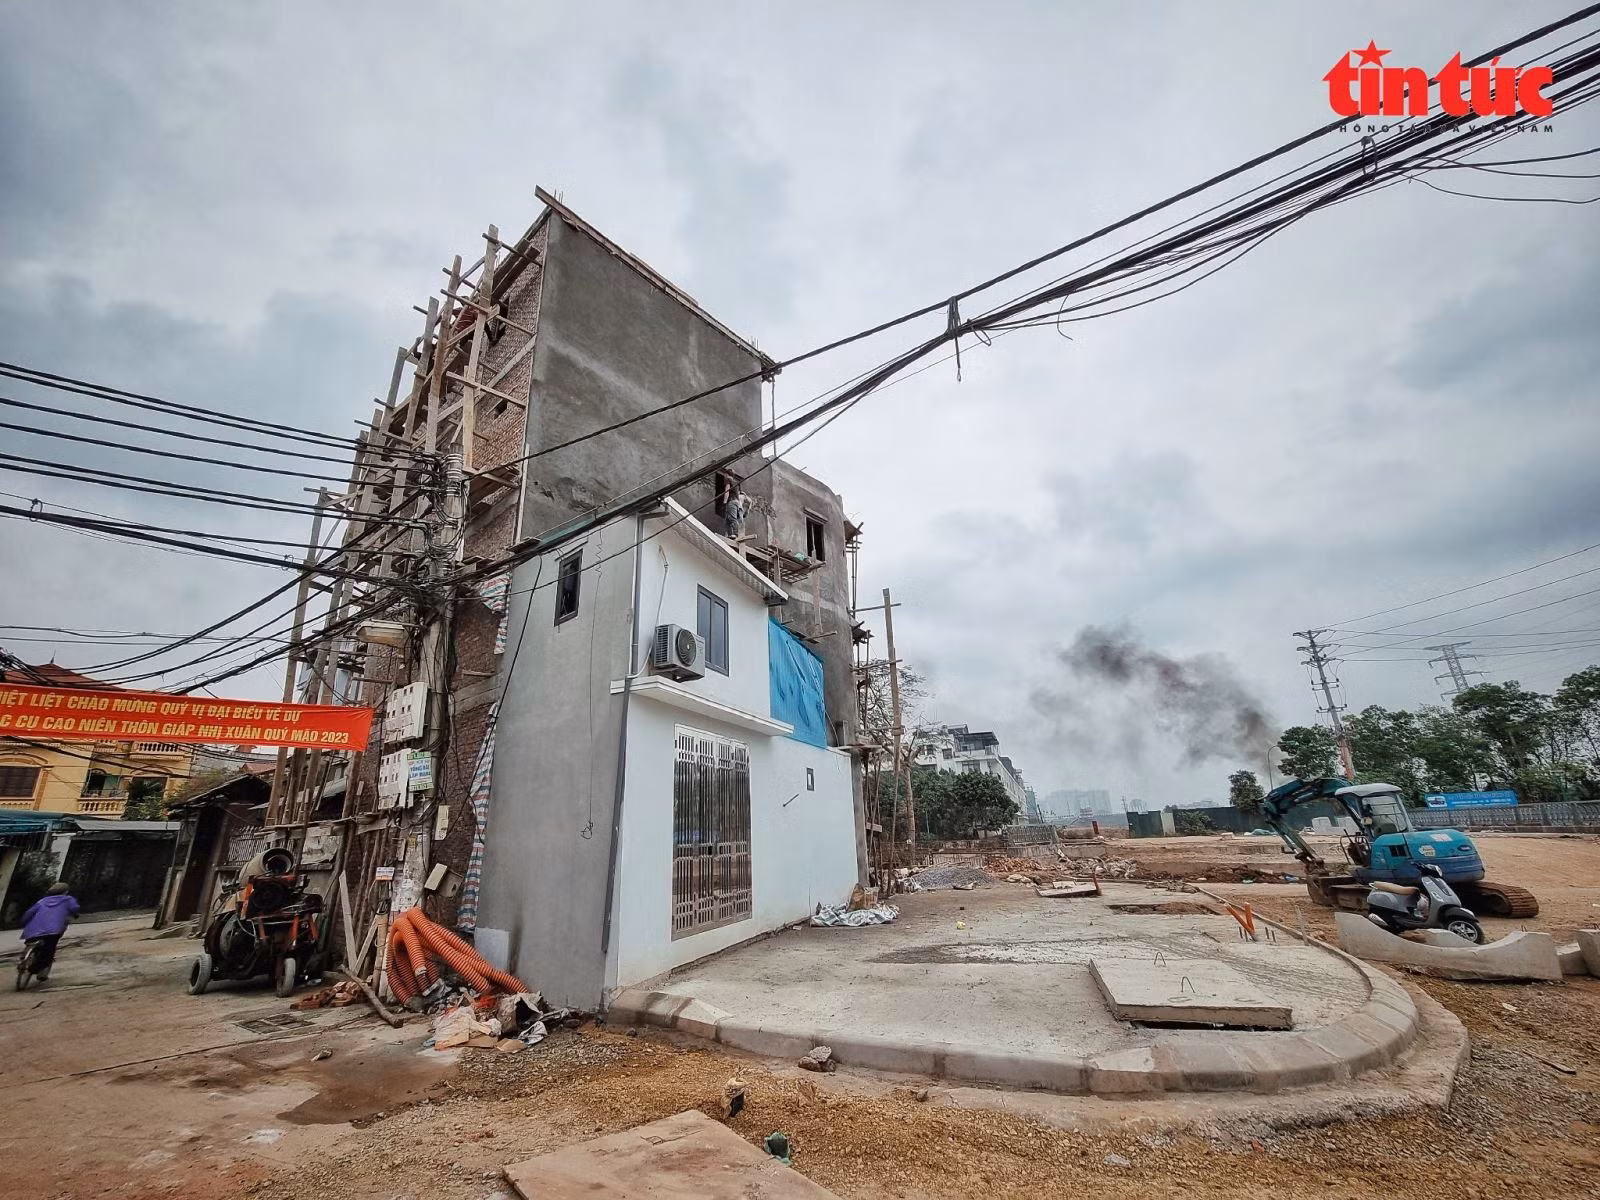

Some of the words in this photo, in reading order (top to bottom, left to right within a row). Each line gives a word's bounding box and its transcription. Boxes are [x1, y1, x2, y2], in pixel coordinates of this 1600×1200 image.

[30, 692, 65, 710] LIỆT
[67, 695, 109, 710] CHÀO
[112, 697, 157, 713] MỪNG
[160, 701, 189, 716] QUÝ
[191, 704, 205, 719] VỊ
[207, 705, 230, 720] ĐẠI
[15, 715, 40, 731] CỤ
[42, 716, 75, 730] CAO
[78, 717, 117, 733] NIÊN
[121, 720, 159, 734] THÔN
[162, 721, 195, 736] GIÁP
[197, 724, 222, 740] NHỊ
[225, 724, 261, 740] XUÂN
[263, 726, 289, 741] QUÝ
[320, 731, 349, 744] 2023
